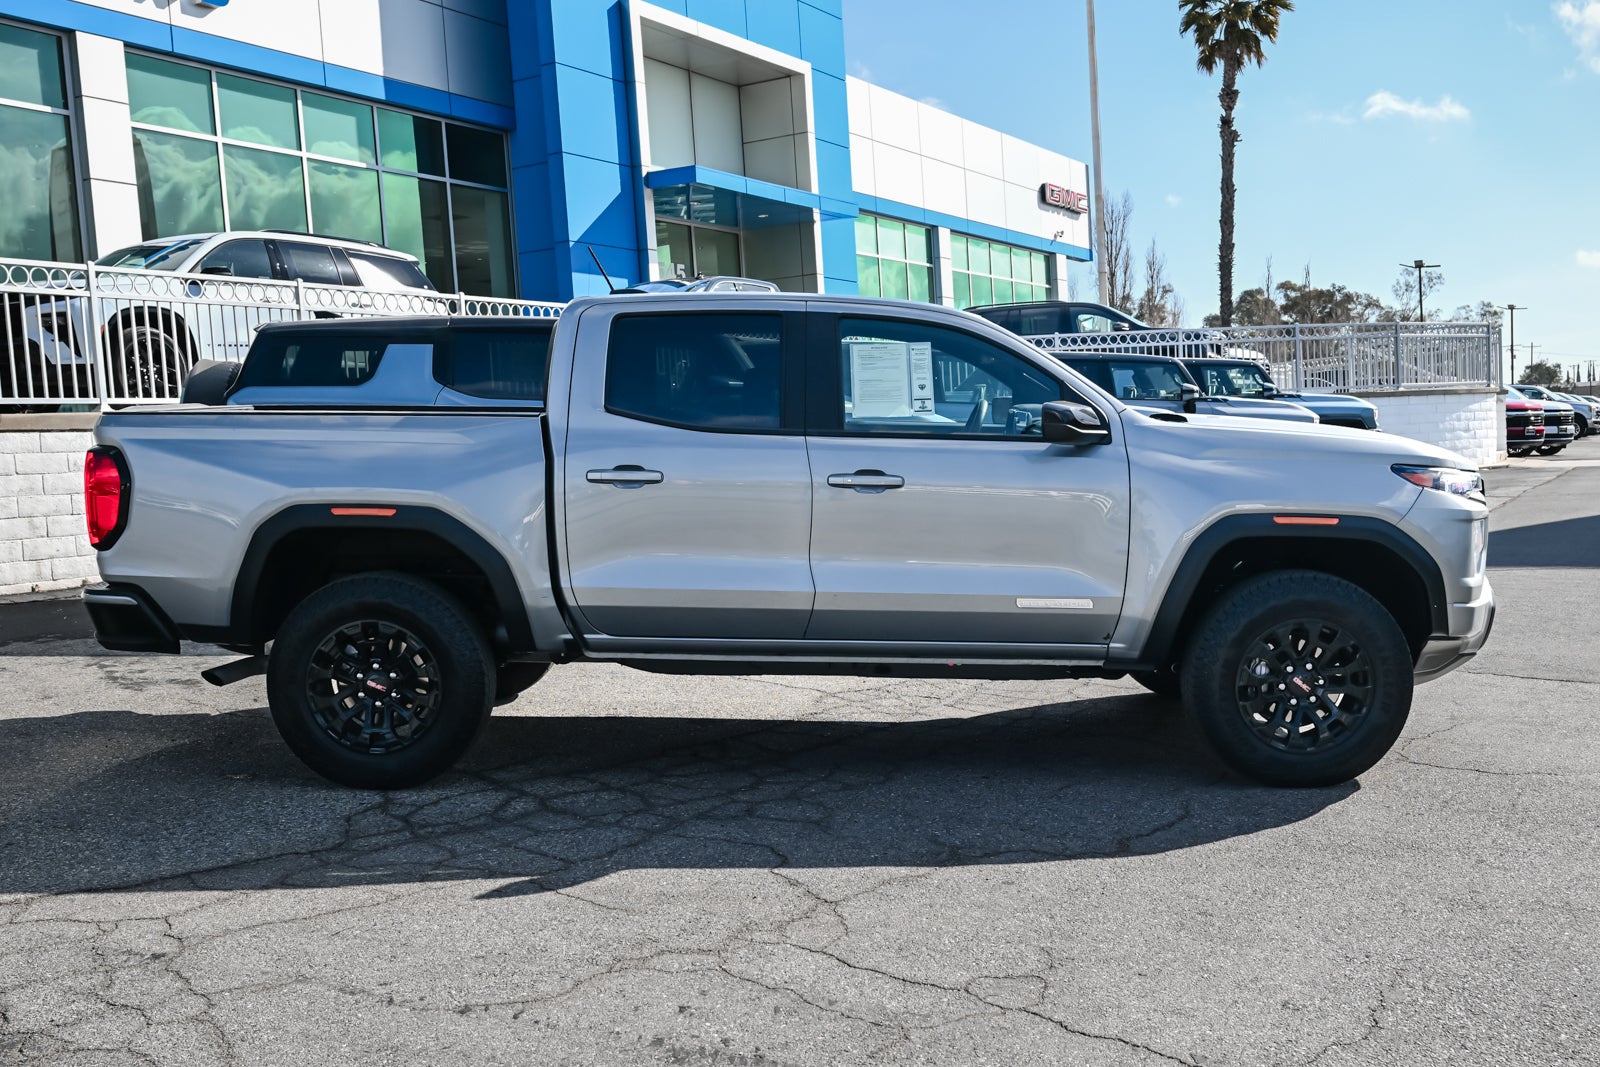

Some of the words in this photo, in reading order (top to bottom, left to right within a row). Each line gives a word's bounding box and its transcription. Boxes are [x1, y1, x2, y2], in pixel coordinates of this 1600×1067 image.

[1046, 182, 1088, 213] GMC
[366, 680, 387, 692] GMC
[1292, 676, 1311, 692] GMC
